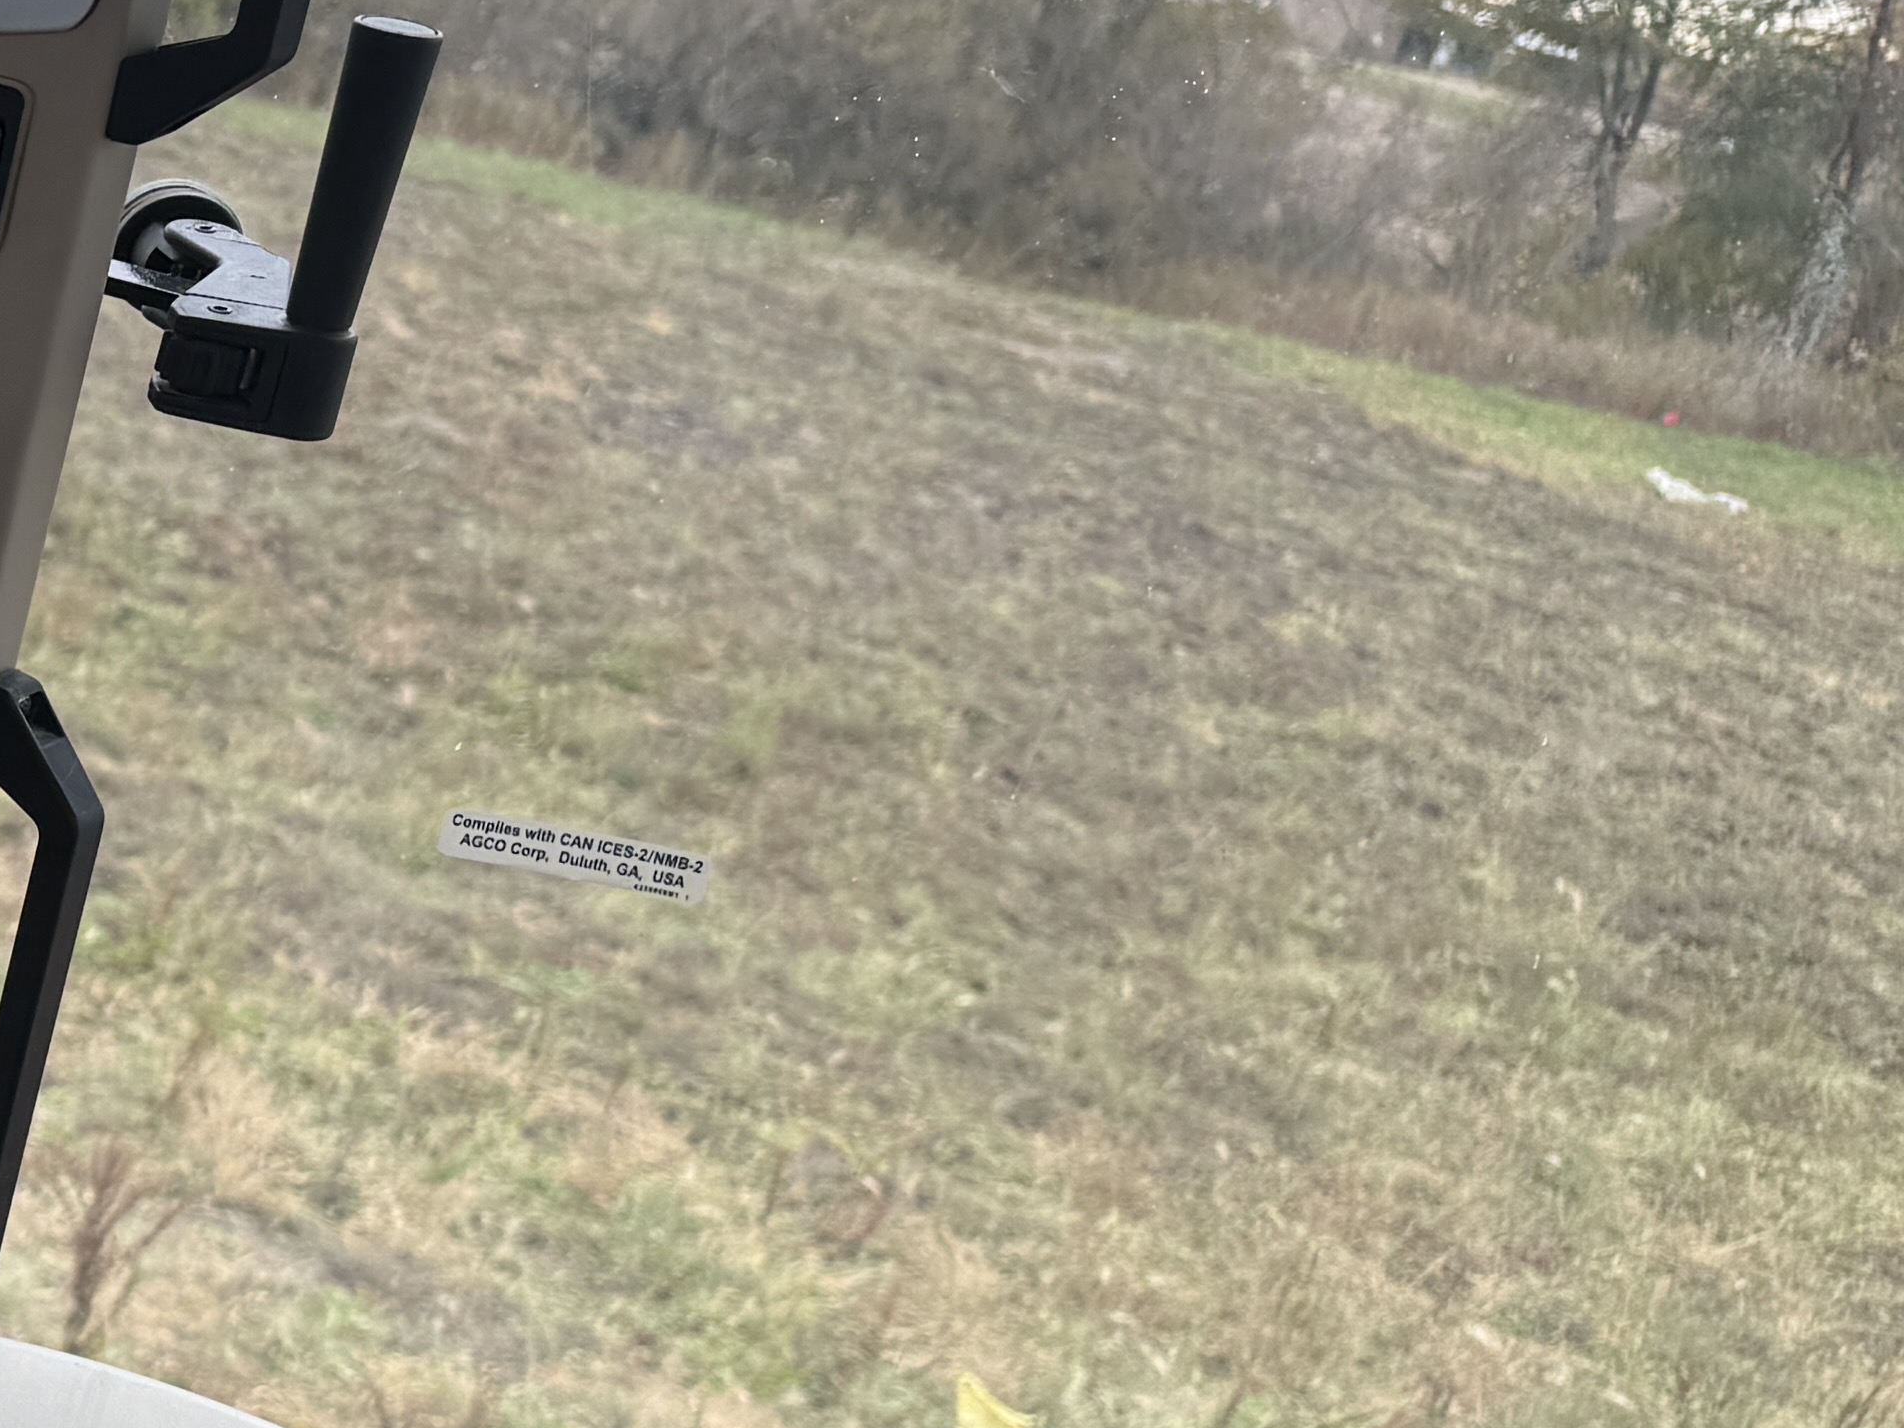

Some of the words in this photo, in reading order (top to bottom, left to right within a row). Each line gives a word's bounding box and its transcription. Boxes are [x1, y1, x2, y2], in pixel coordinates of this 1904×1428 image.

[459, 832, 507, 853] AGCO
[558, 850, 612, 876] Duluth,
[616, 862, 643, 881] GA,
[652, 869, 685, 889] USA
[525, 827, 557, 845] with
[559, 832, 595, 852] CAN
[596, 838, 705, 874] ICES-2/NMB-2
